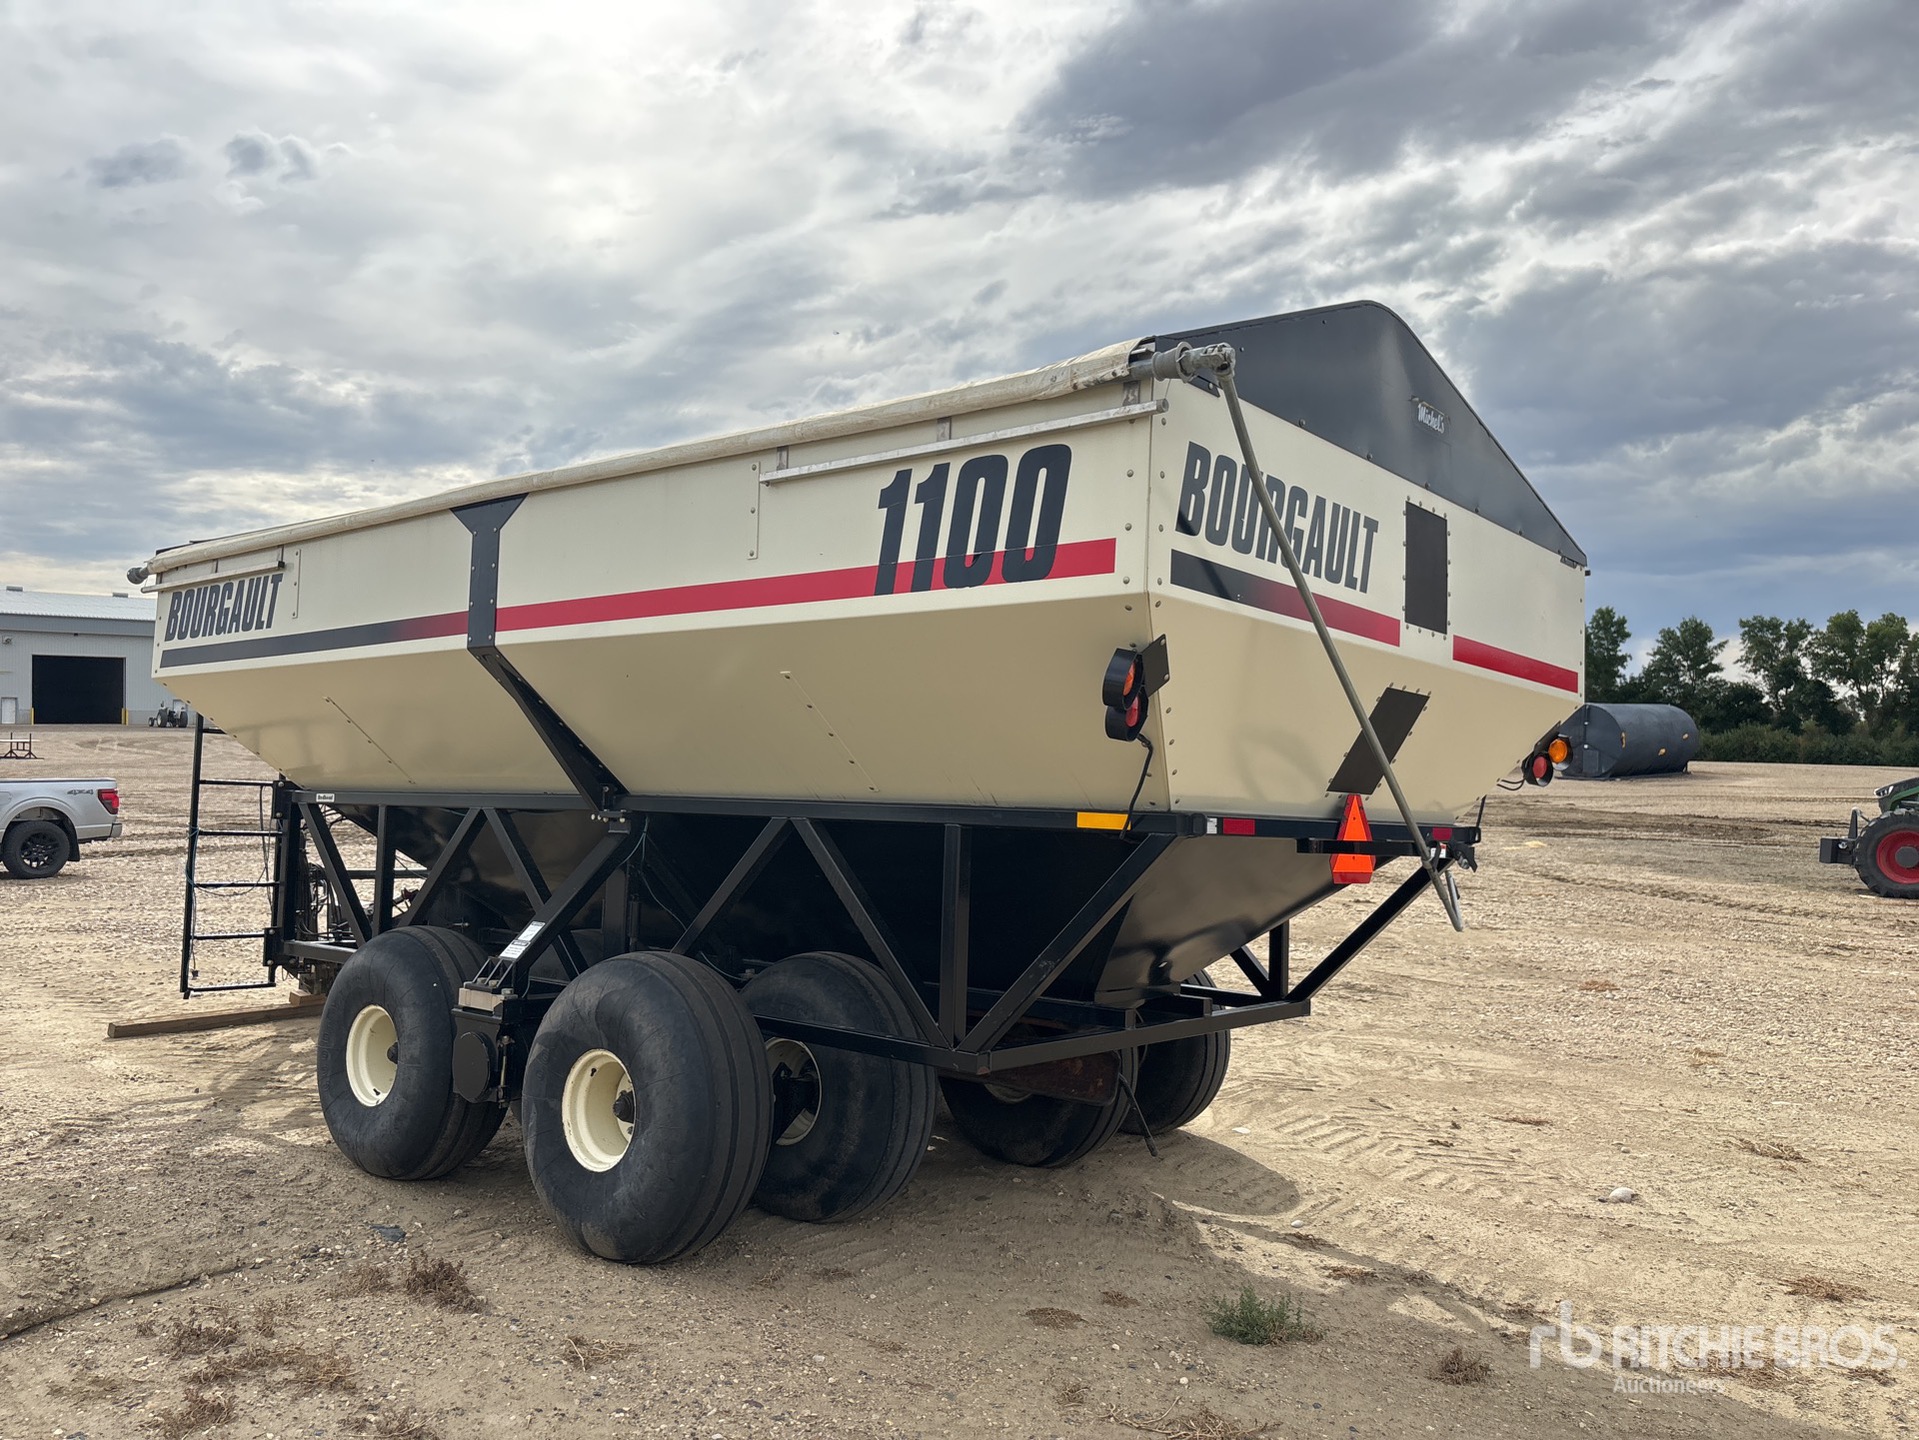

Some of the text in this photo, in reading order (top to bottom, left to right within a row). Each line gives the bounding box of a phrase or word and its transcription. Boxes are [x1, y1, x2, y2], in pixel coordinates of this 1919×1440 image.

[874, 444, 1072, 596] 1100
[1175, 441, 1379, 594] BOURGAULT
[164, 573, 284, 642] BOURGAULT
